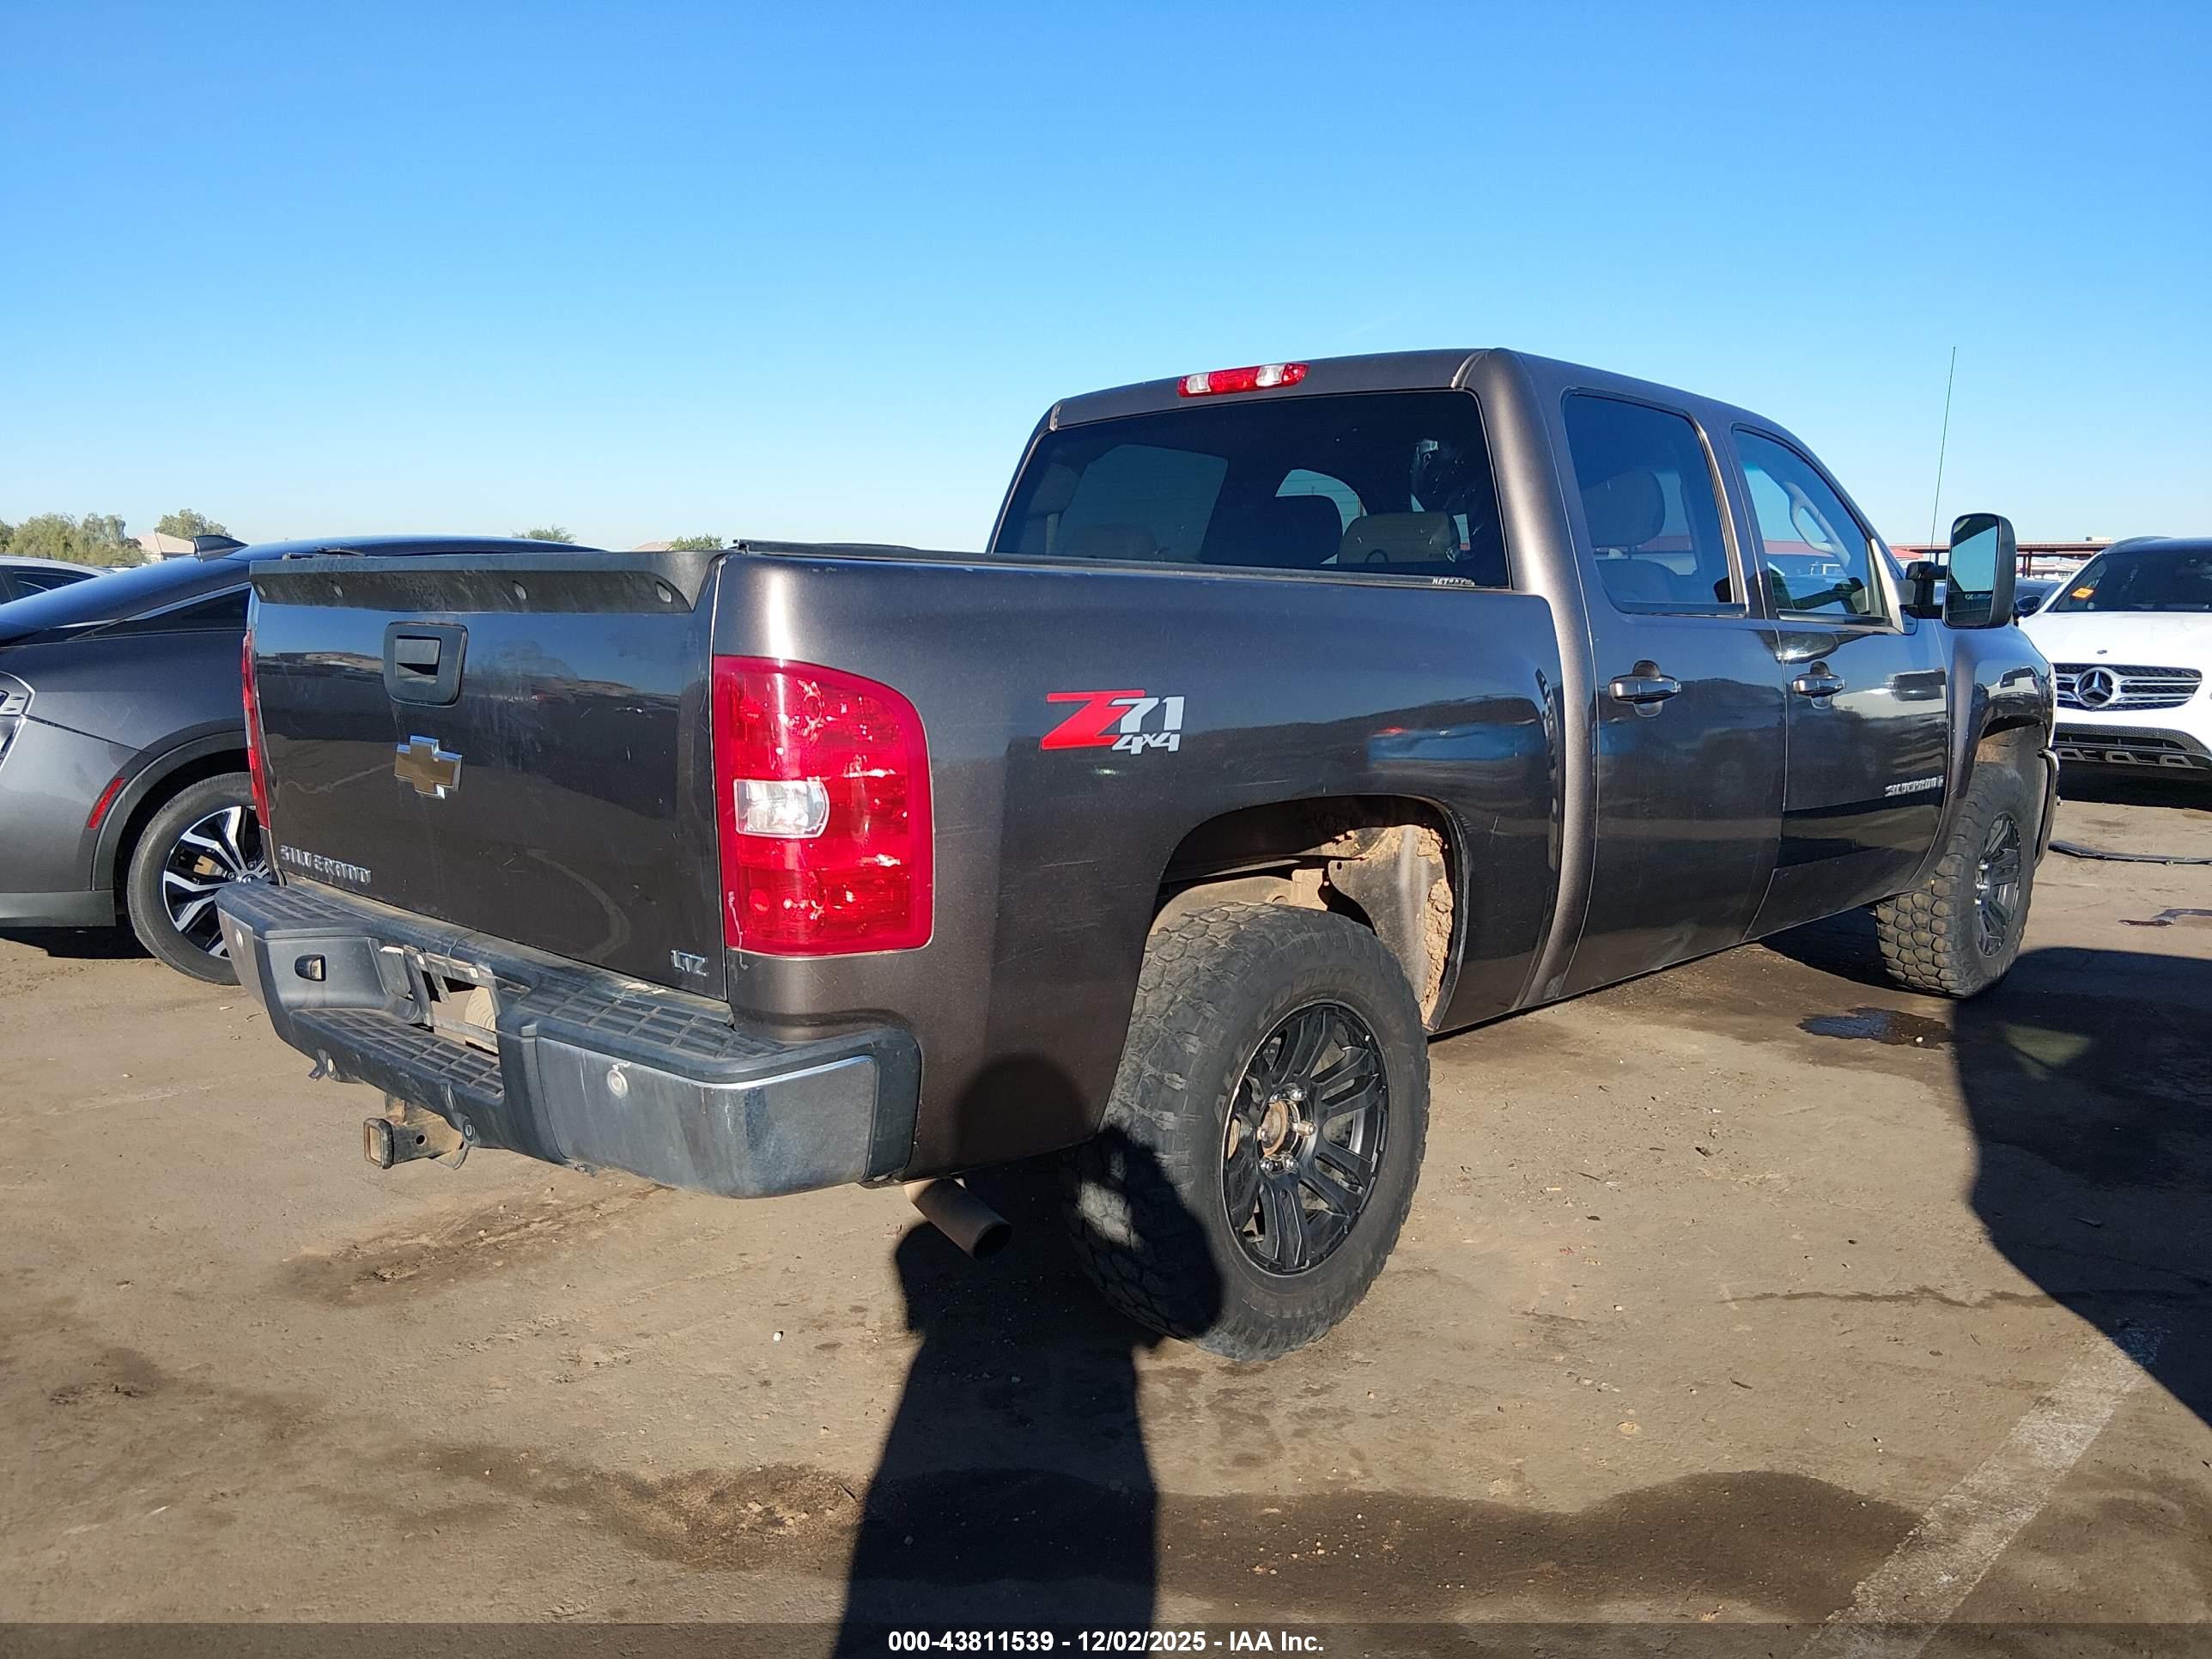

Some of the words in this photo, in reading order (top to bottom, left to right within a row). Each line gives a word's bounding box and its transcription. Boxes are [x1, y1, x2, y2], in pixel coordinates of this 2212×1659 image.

[1041, 690, 1185, 750] Z71
[280, 844, 371, 884] SILVERADO
[671, 950, 709, 977] LTZ
